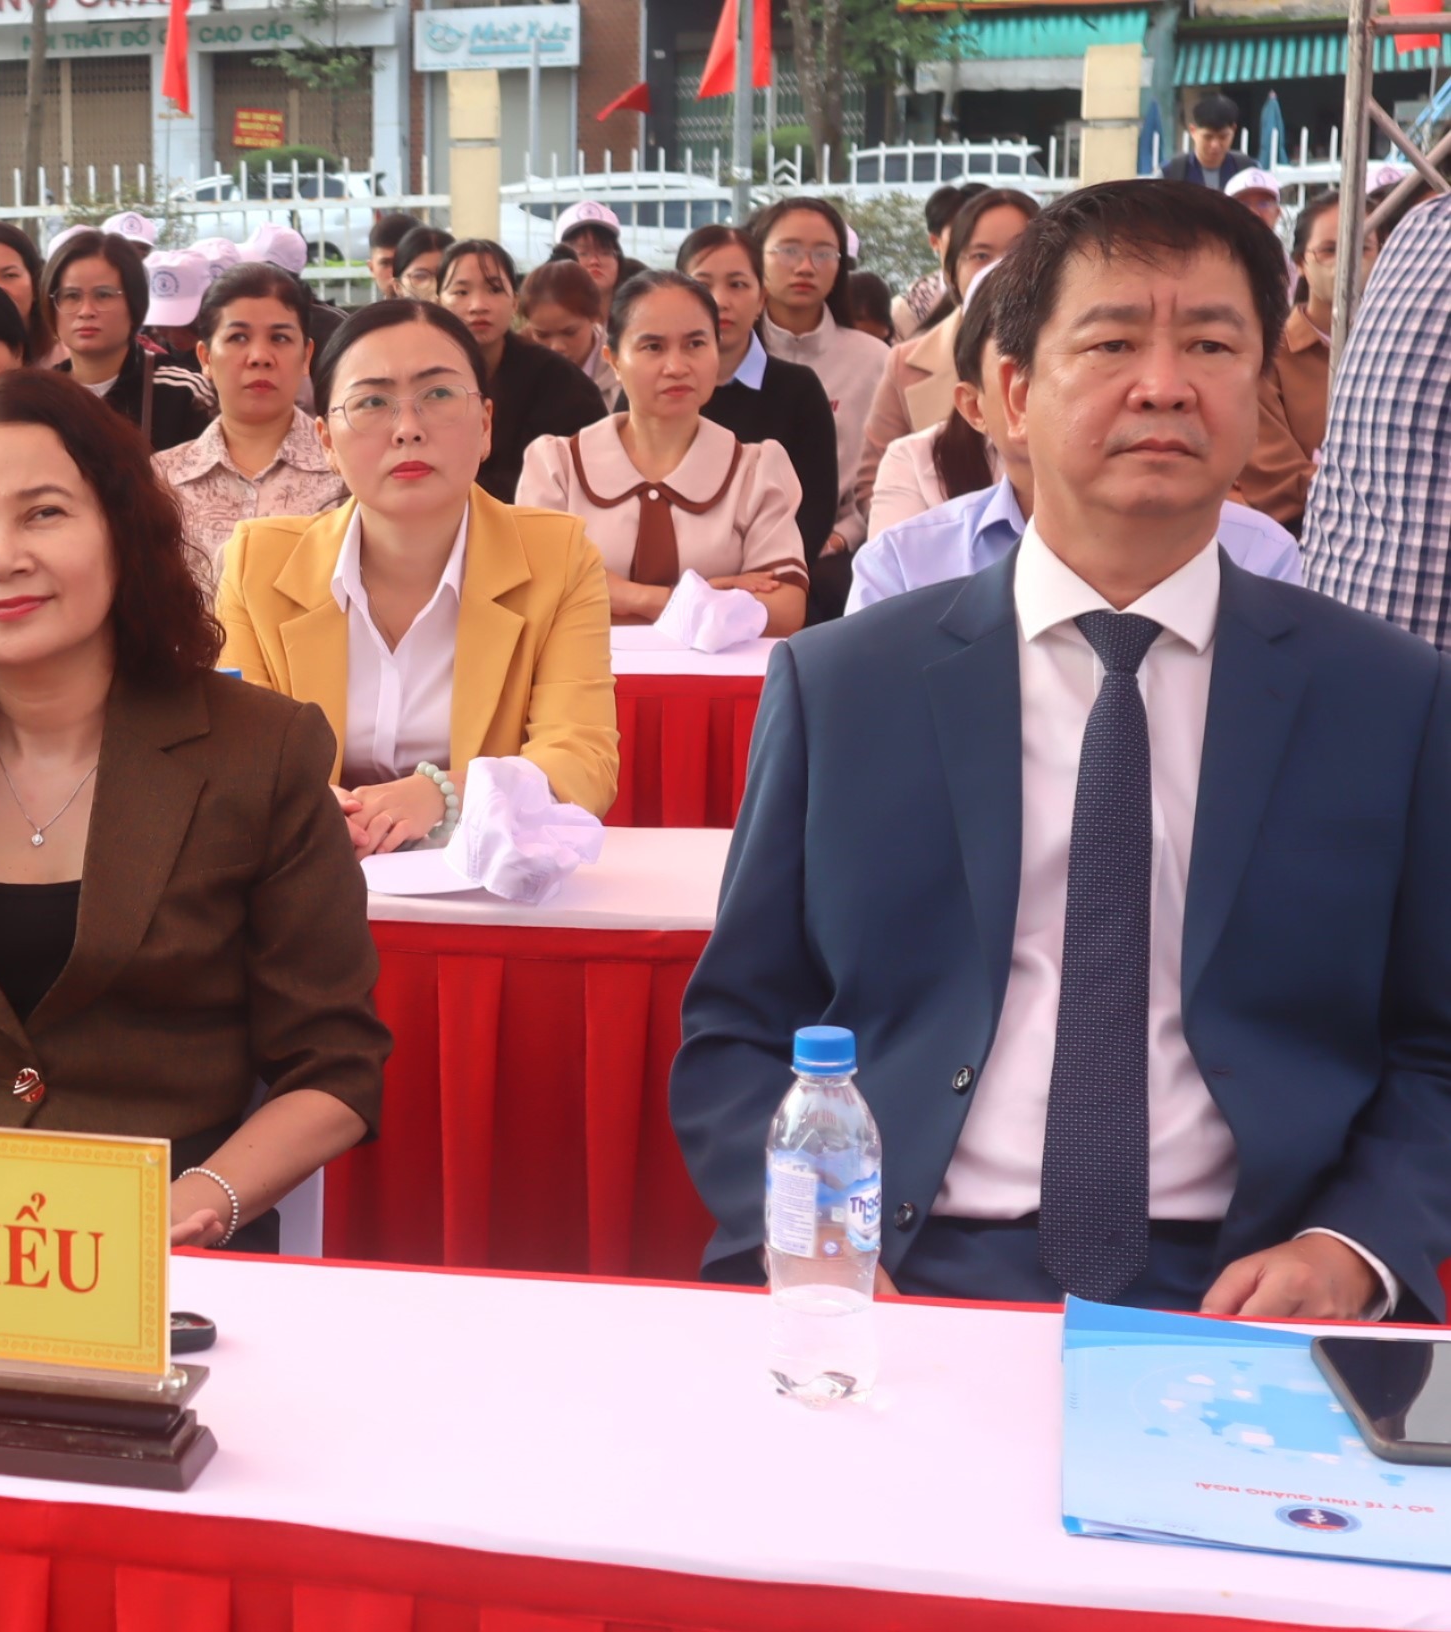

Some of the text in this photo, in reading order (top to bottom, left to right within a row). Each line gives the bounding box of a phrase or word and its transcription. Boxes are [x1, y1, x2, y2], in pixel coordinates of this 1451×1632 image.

[62, 26, 113, 49] THẤT
[199, 25, 243, 43] CAO
[251, 18, 293, 41] CẤP
